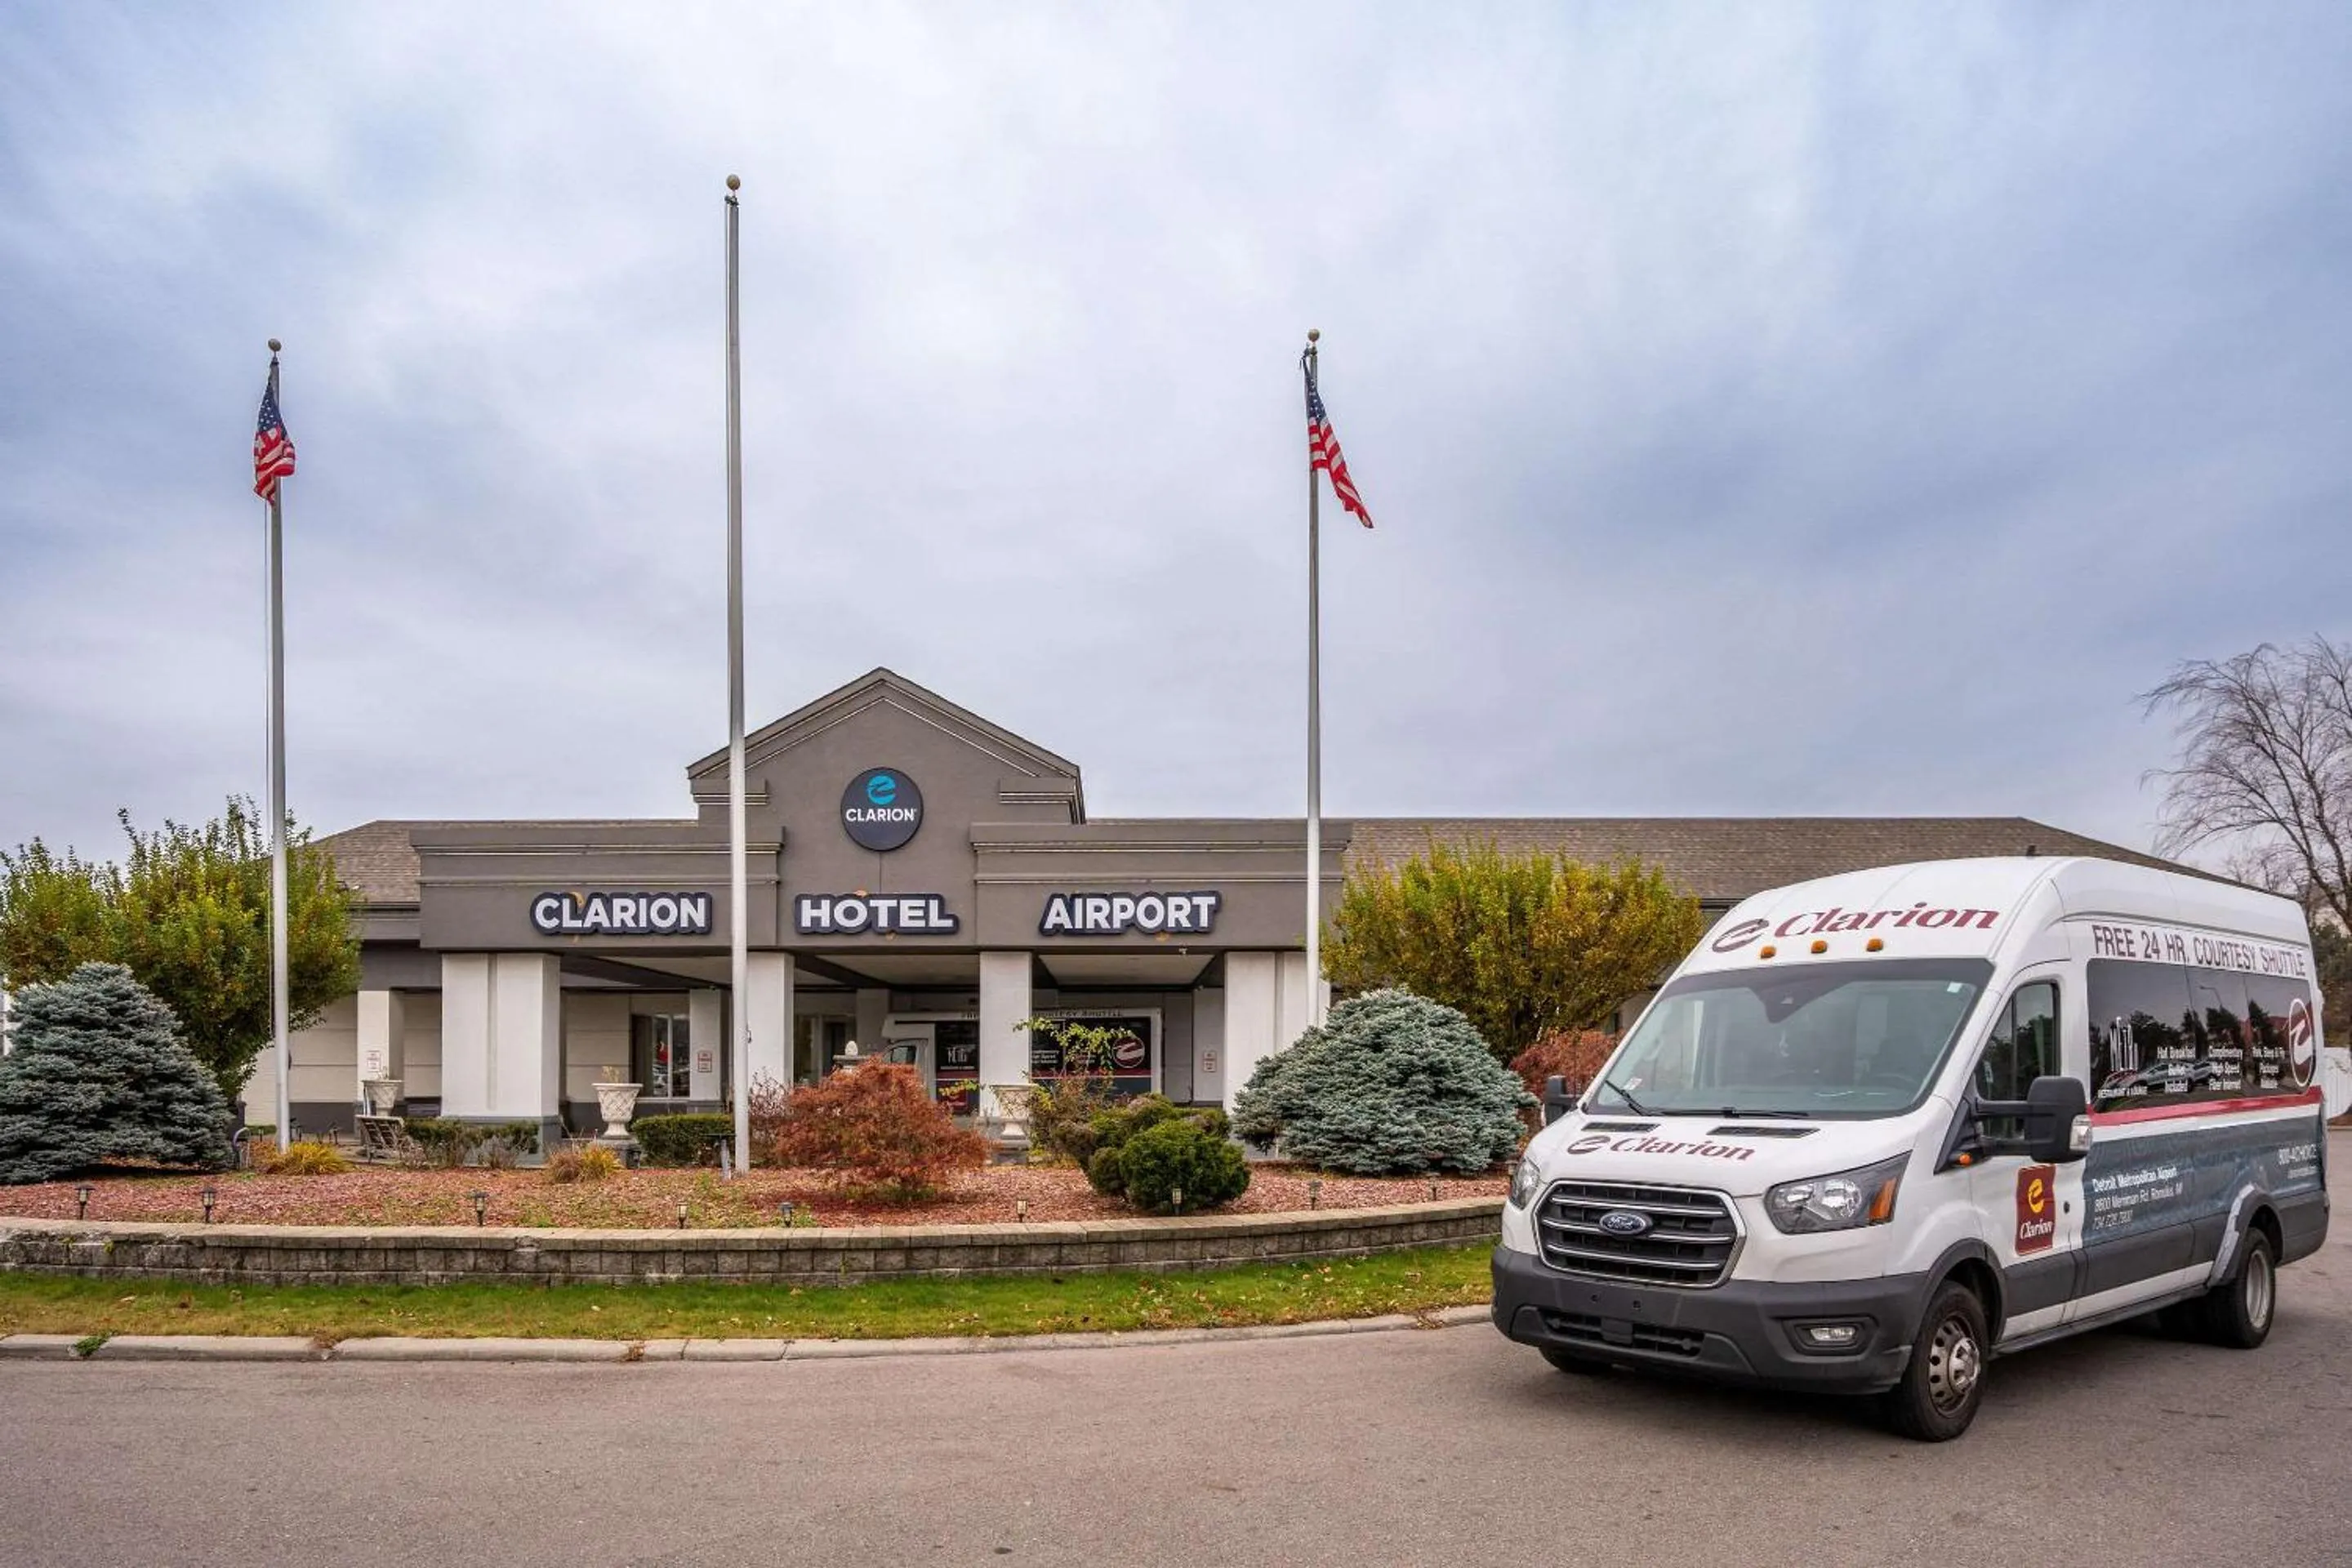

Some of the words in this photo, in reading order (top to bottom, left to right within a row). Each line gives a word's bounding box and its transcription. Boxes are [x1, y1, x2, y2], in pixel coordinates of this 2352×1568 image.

[846, 808, 915, 822] CLARION
[535, 898, 706, 929] CLARION
[800, 899, 954, 928] HOTEL
[1043, 897, 1216, 929] AIRPORT
[1774, 902, 1999, 938] Clarion
[2091, 924, 2136, 958] FREE
[2140, 930, 2160, 960] 24
[2194, 936, 2257, 971] COURTESY
[2260, 946, 2306, 977] SHUTTLE
[1610, 1137, 1755, 1160] Clarion
[2091, 1176, 2118, 1192] Detroit
[2118, 1169, 2157, 1188] Metropolitan
[2158, 1165, 2177, 1182] Airport
[1607, 1216, 1633, 1230] Ford
[2020, 1218, 2053, 1241] Clarion
